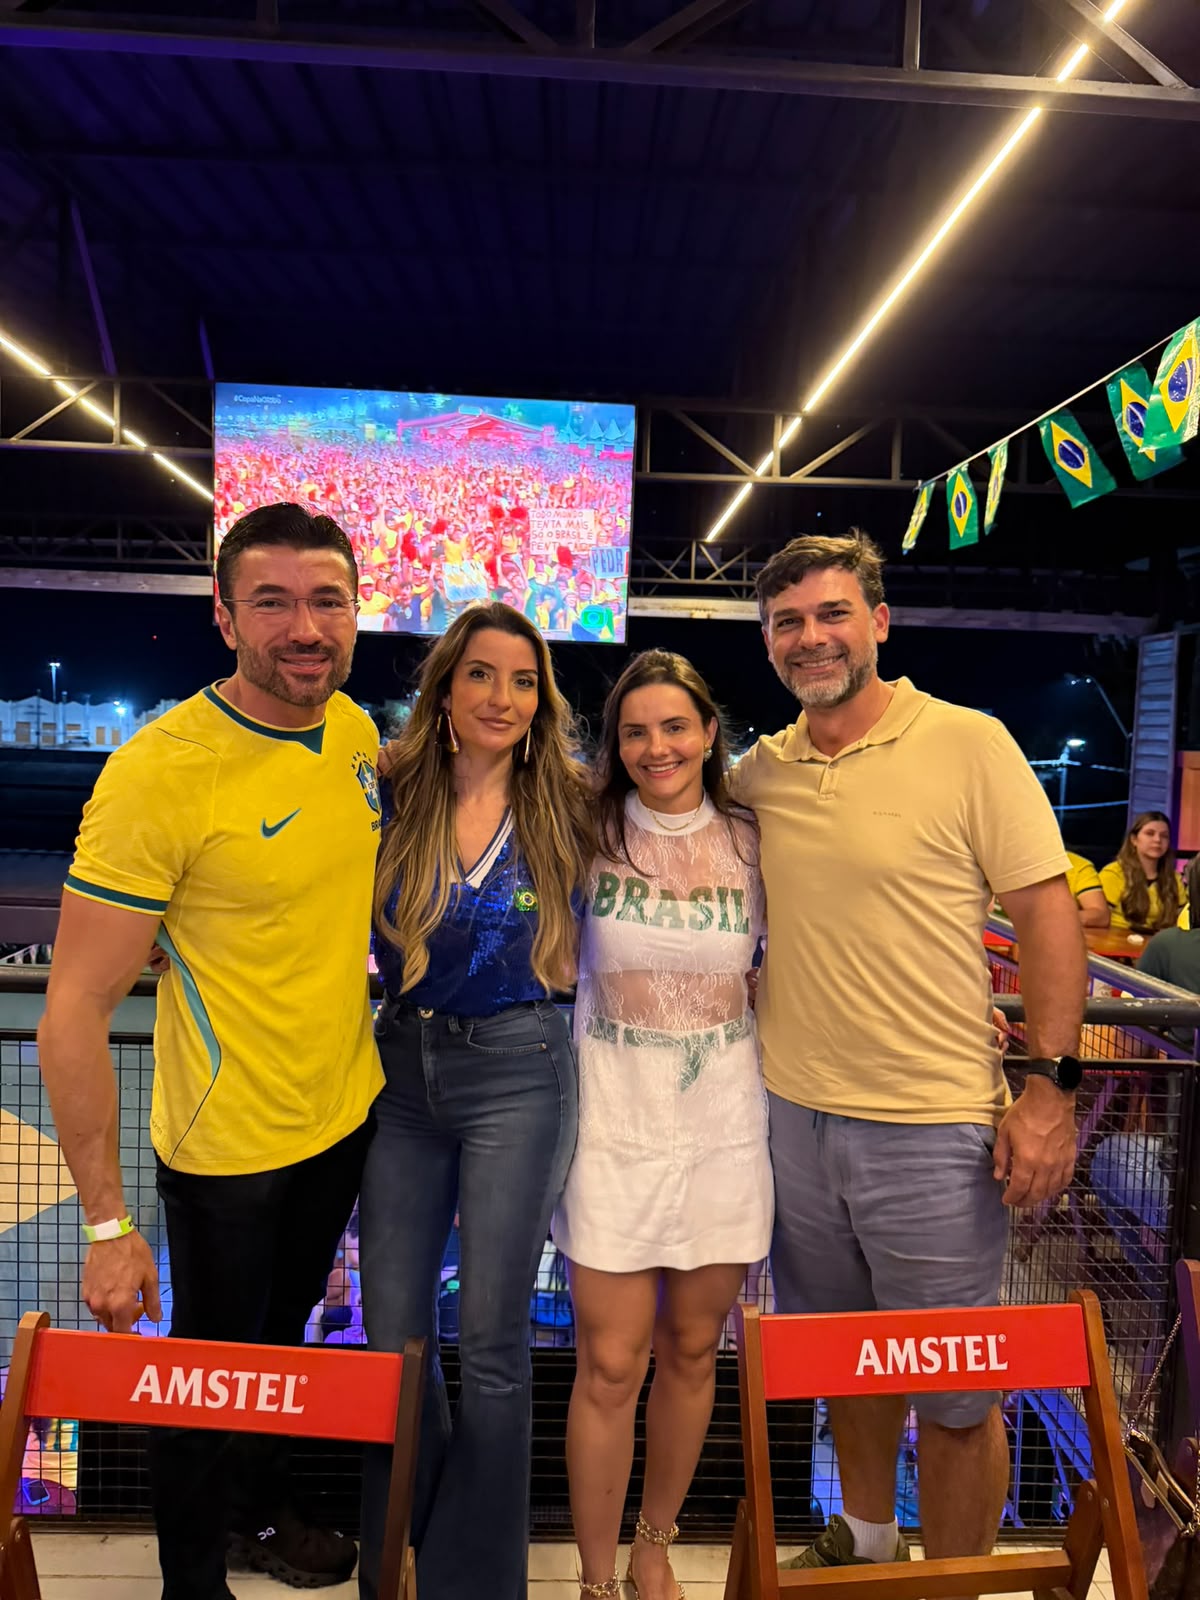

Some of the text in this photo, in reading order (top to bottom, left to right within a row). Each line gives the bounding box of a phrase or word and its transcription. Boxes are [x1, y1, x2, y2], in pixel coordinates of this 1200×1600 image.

[530, 519, 562, 529] TENTA
[547, 530, 554, 538] O
[592, 872, 750, 934] BRASIL
